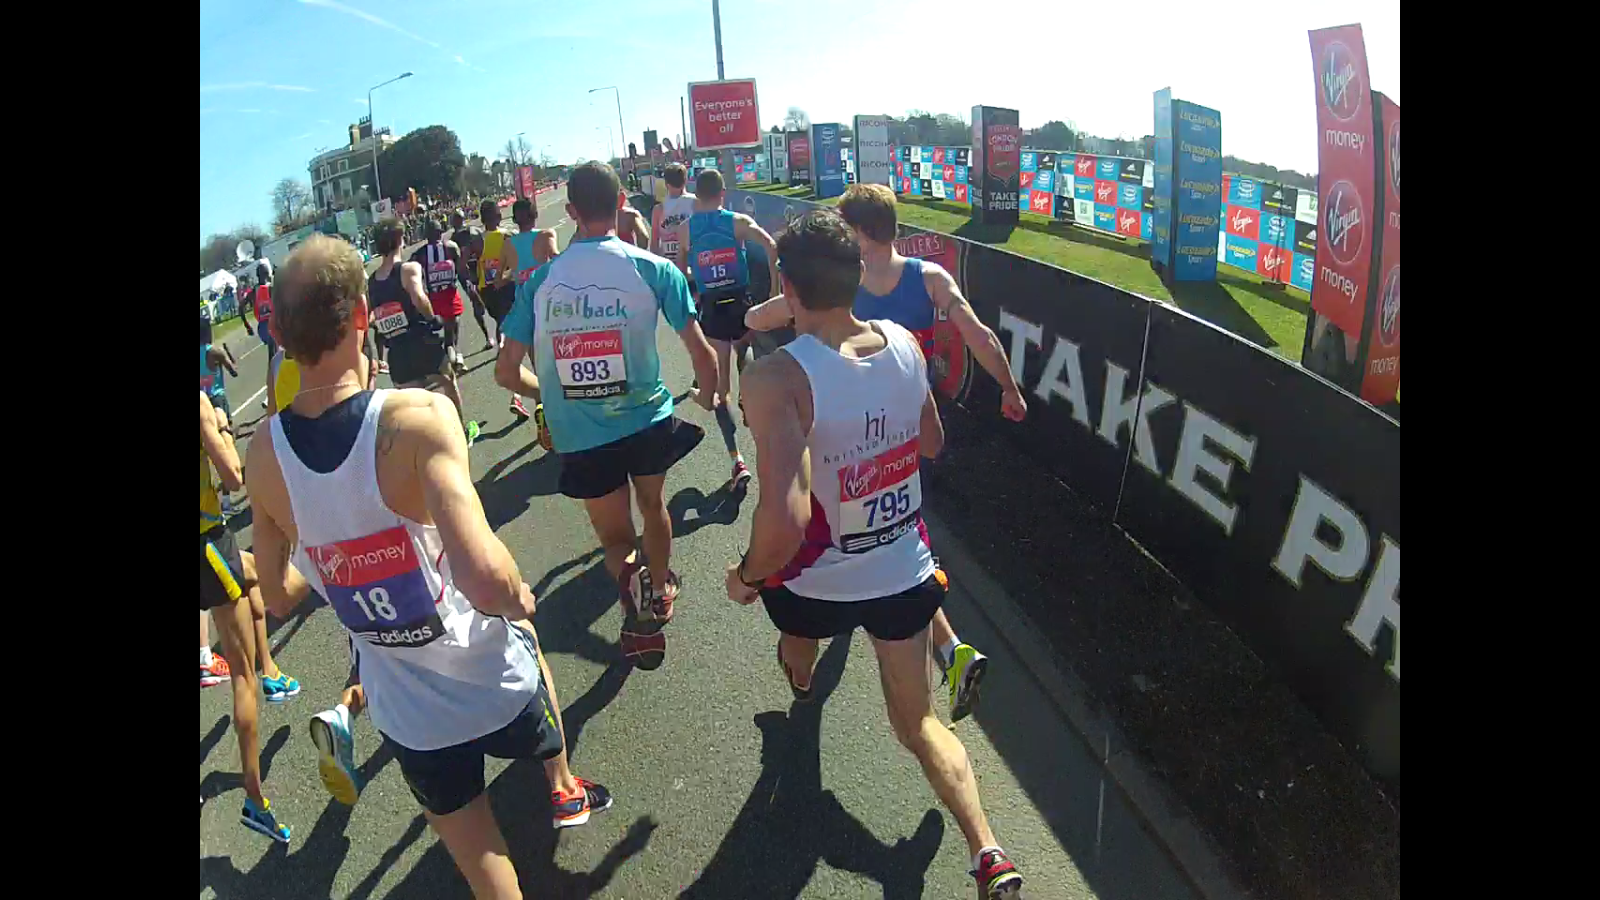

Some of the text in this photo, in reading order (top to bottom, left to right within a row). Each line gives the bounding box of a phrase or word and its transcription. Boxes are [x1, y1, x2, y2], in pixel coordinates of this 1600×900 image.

[1326, 51, 1356, 109] Virgin
[695, 98, 753, 111] Everyone's
[709, 111, 742, 122] better
[1326, 129, 1365, 155] money
[989, 201, 1018, 211] PRIDE
[990, 191, 1017, 201] TAKE
[1328, 190, 1360, 252] Virgin
[711, 265, 726, 278] 15
[1321, 266, 1358, 304] money
[380, 315, 404, 331] 1088
[558, 336, 619, 357] Virgin money
[571, 359, 610, 382] 893
[586, 385, 621, 397] adidas
[865, 408, 887, 442] hj
[1000, 306, 1258, 536] TAKE
[848, 449, 918, 497] Virgin money
[863, 484, 910, 528] 795
[351, 541, 406, 568] money
[352, 587, 398, 621] 18
[380, 625, 433, 644] adidas
